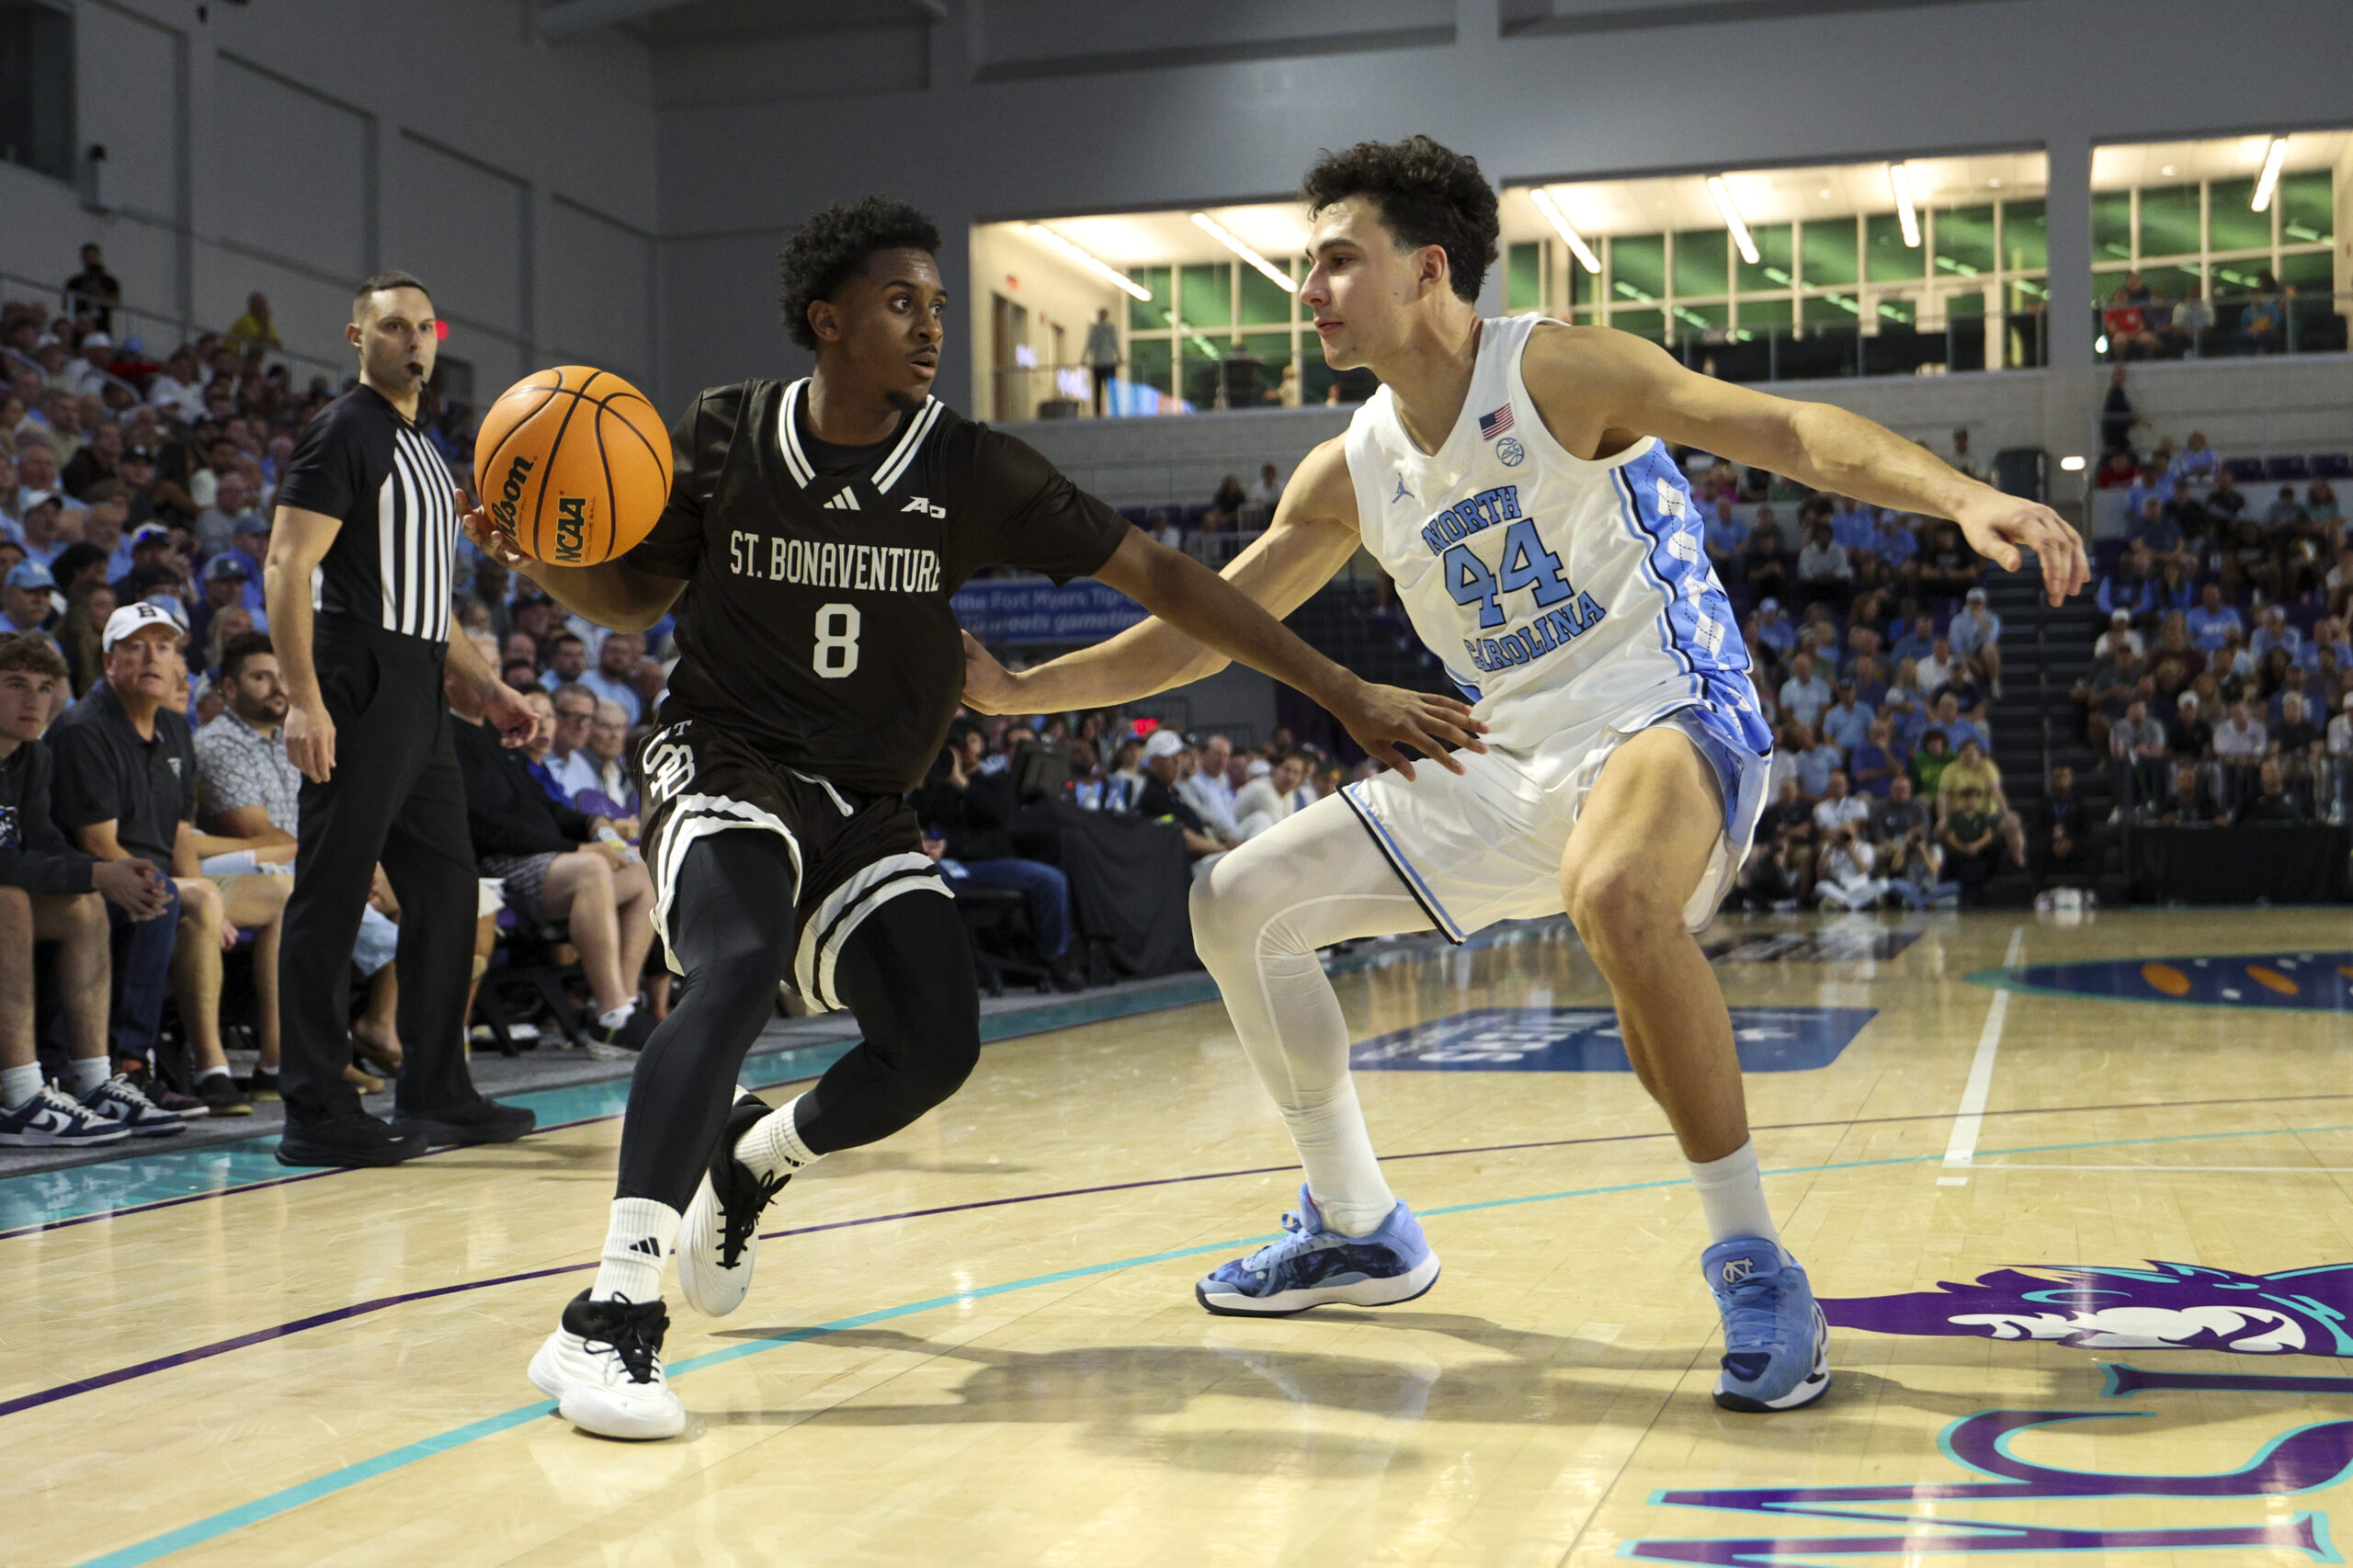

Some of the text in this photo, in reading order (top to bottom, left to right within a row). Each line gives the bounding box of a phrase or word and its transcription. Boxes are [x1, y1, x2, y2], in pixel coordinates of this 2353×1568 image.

[491, 455, 535, 551] ilson
[554, 496, 586, 562] NCAA
[1421, 485, 1522, 557] NORTH
[730, 529, 941, 593] ST. BONAVENTURE
[1442, 517, 1575, 629] 44
[990, 590, 1030, 610] Fort
[1032, 589, 1087, 610] Myers
[813, 603, 861, 678] 8
